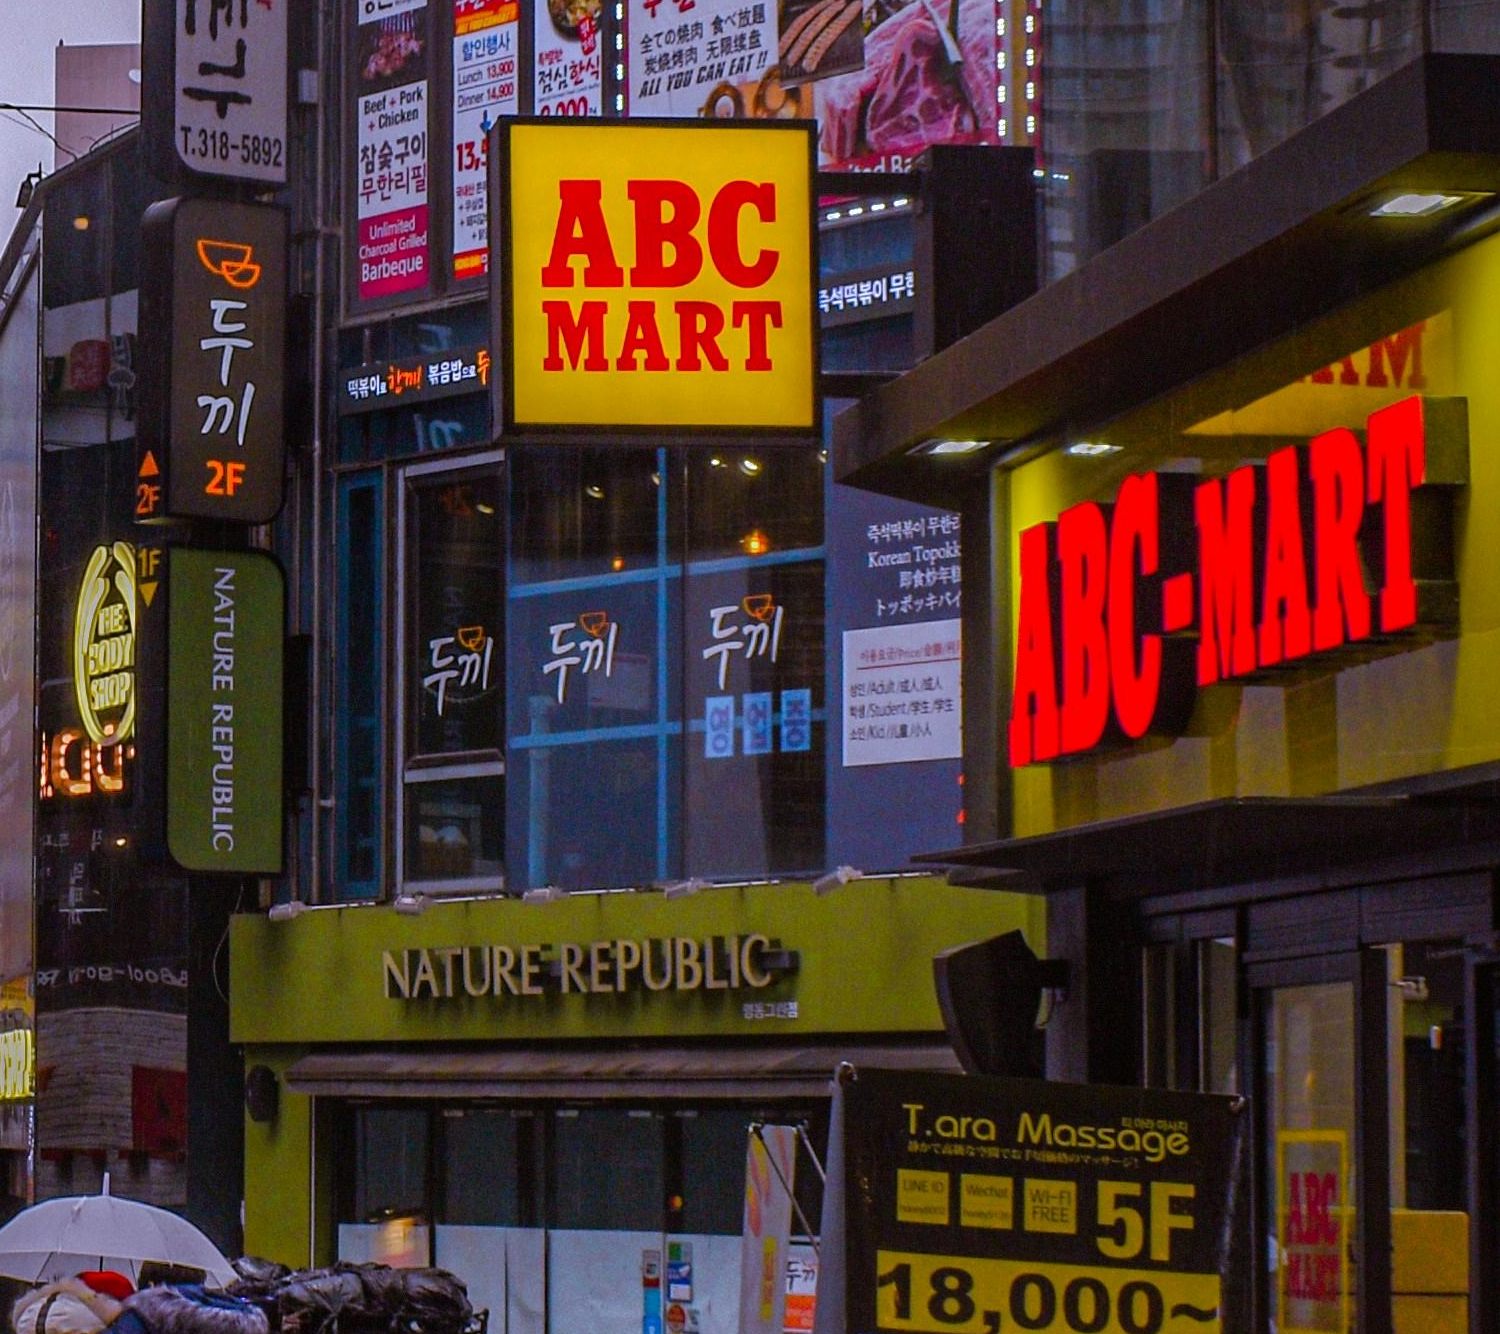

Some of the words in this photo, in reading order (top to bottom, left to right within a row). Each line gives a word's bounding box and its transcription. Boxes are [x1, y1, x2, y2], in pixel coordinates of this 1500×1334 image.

[364, 91, 387, 114] Beef
[399, 85, 424, 106] Pork
[638, 77, 662, 99] ALL
[666, 69, 692, 91] YOU
[696, 64, 724, 87] CAN
[179, 126, 283, 167] T.318-5892
[378, 107, 420, 129] Chicken
[359, 163, 428, 205] 무한리필
[360, 131, 427, 175] 참숯구이
[368, 214, 416, 240] Unlimited
[540, 178, 782, 289] ABC
[361, 253, 424, 284] Barbeque
[542, 300, 783, 373] MART
[197, 298, 256, 446] 두끼
[205, 459, 246, 496] 2F
[1008, 394, 1427, 768] ABC-MART
[213, 567, 236, 692] NATURE
[543, 620, 620, 705] 두끼
[703, 602, 784, 690] 두끼
[422, 635, 495, 717] 두끼
[212, 700, 236, 853] REPUBLIC
[382, 945, 544, 1001] NATURE
[560, 934, 774, 995] REPUBLIC
[1016, 1112, 1191, 1163] Massage
[1096, 1179, 1196, 1262] 5F
